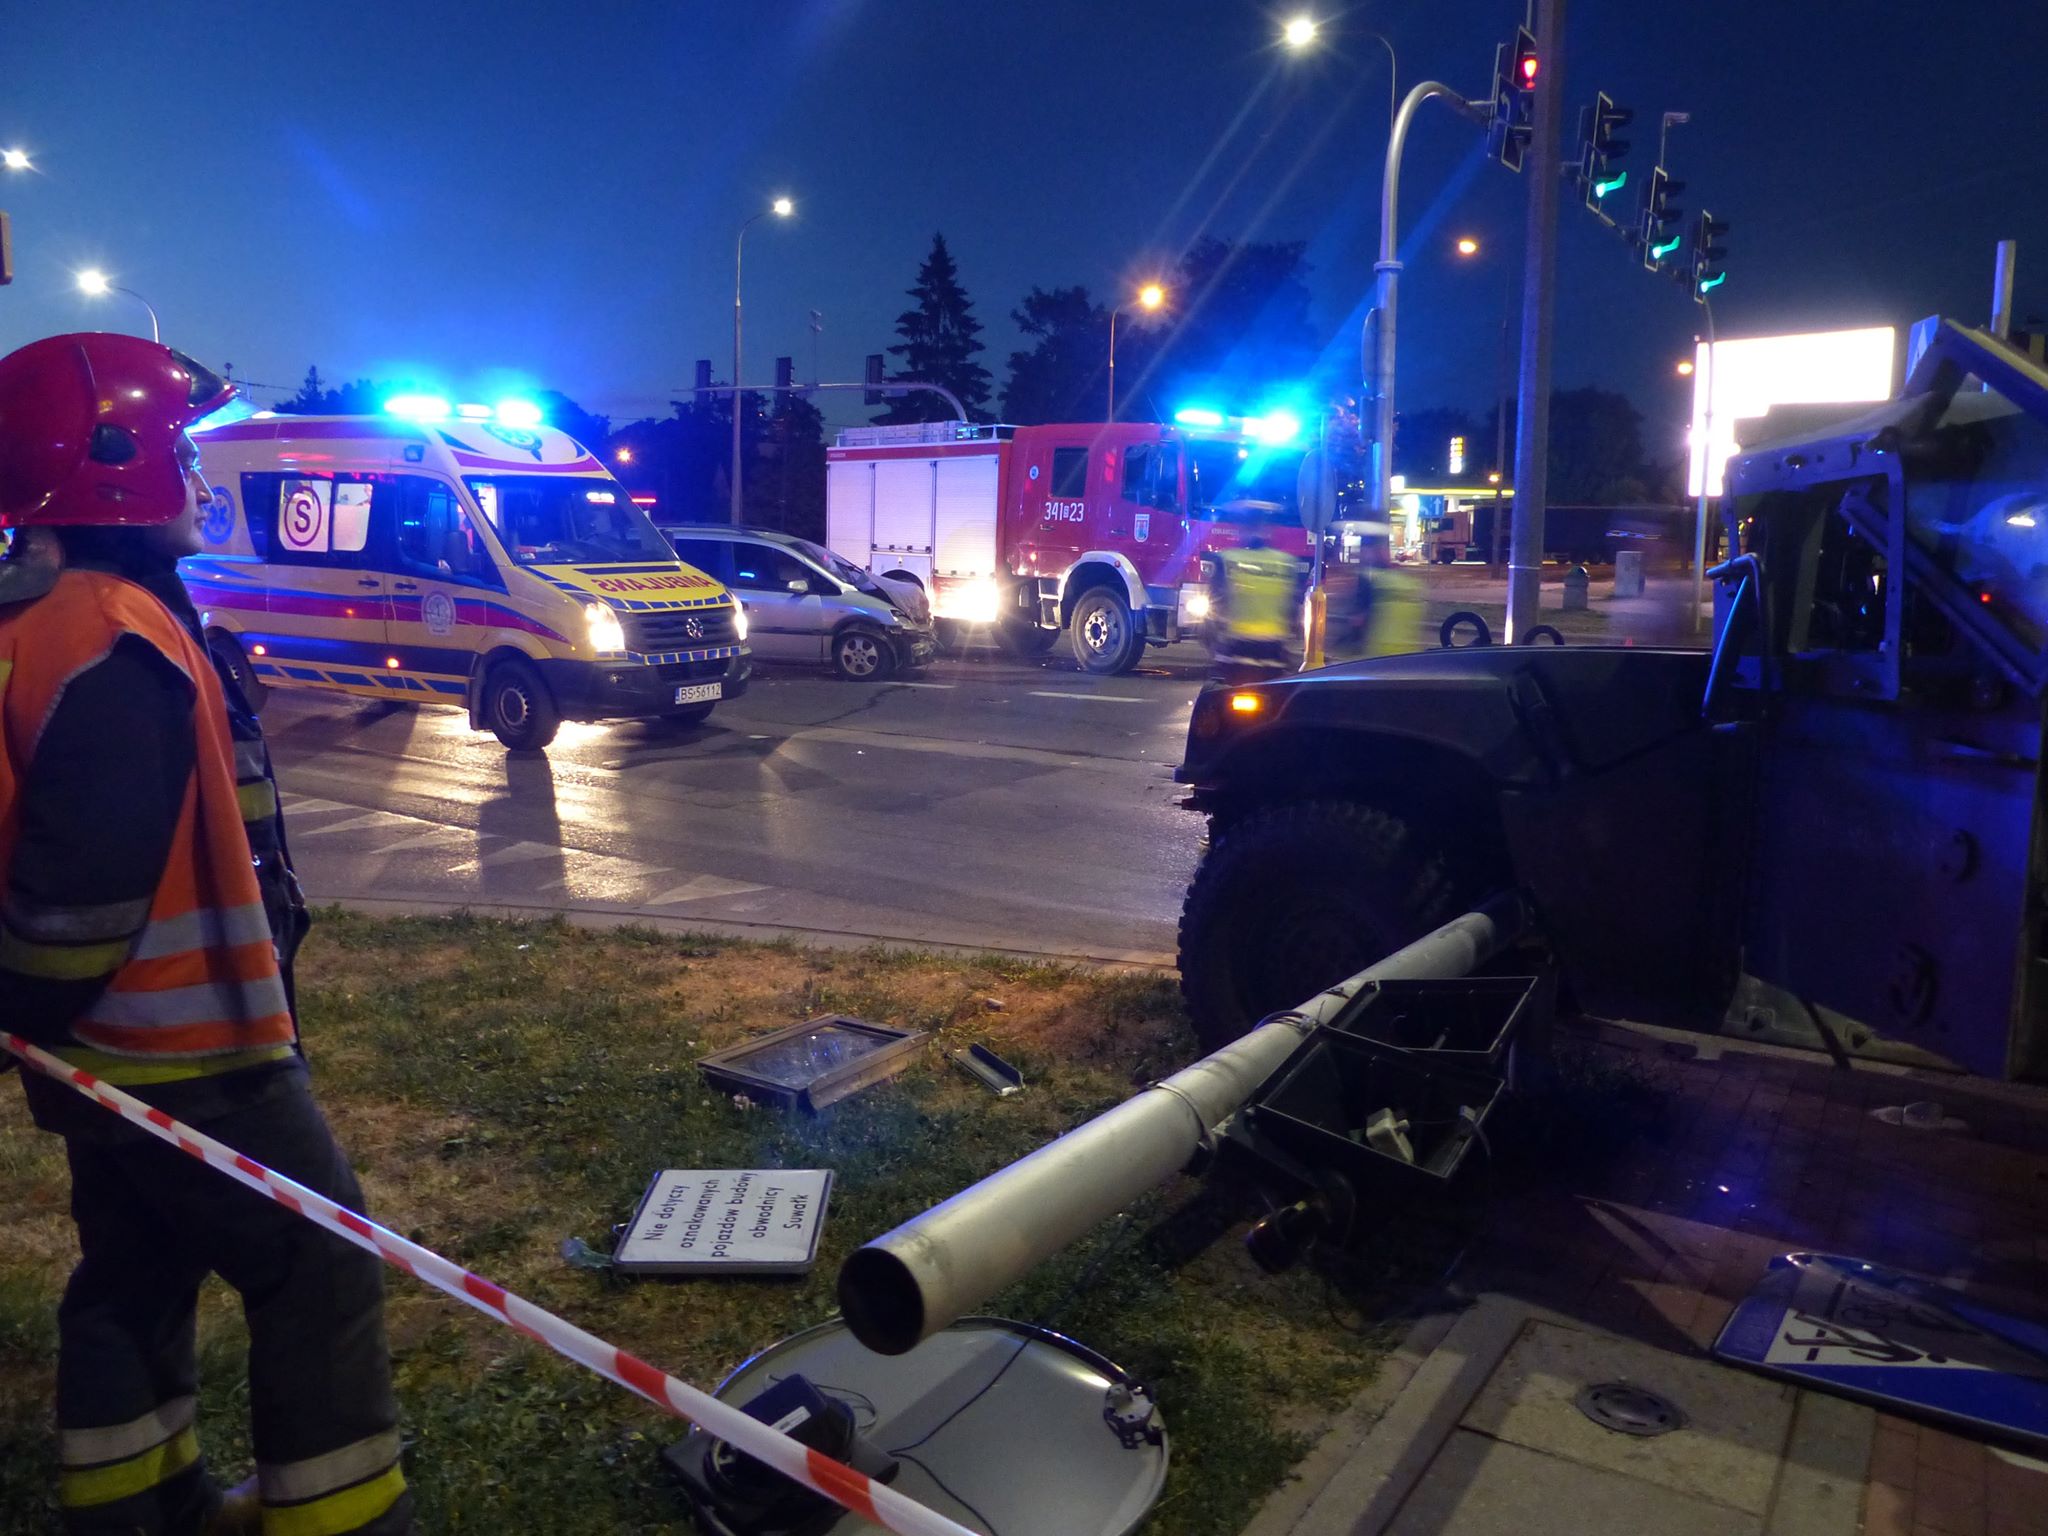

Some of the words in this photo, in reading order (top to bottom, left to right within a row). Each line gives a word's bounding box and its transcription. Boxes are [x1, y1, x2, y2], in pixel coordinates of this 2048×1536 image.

[294, 500, 311, 532] S
[643, 1223, 668, 1241] Nie
[658, 1184, 690, 1219] dotyczy
[680, 1179, 721, 1249] oznakowanych
[711, 1208, 740, 1258] pojazdów
[748, 1186, 785, 1239] obwodnicy
[783, 1194, 810, 1230] Suwałk
